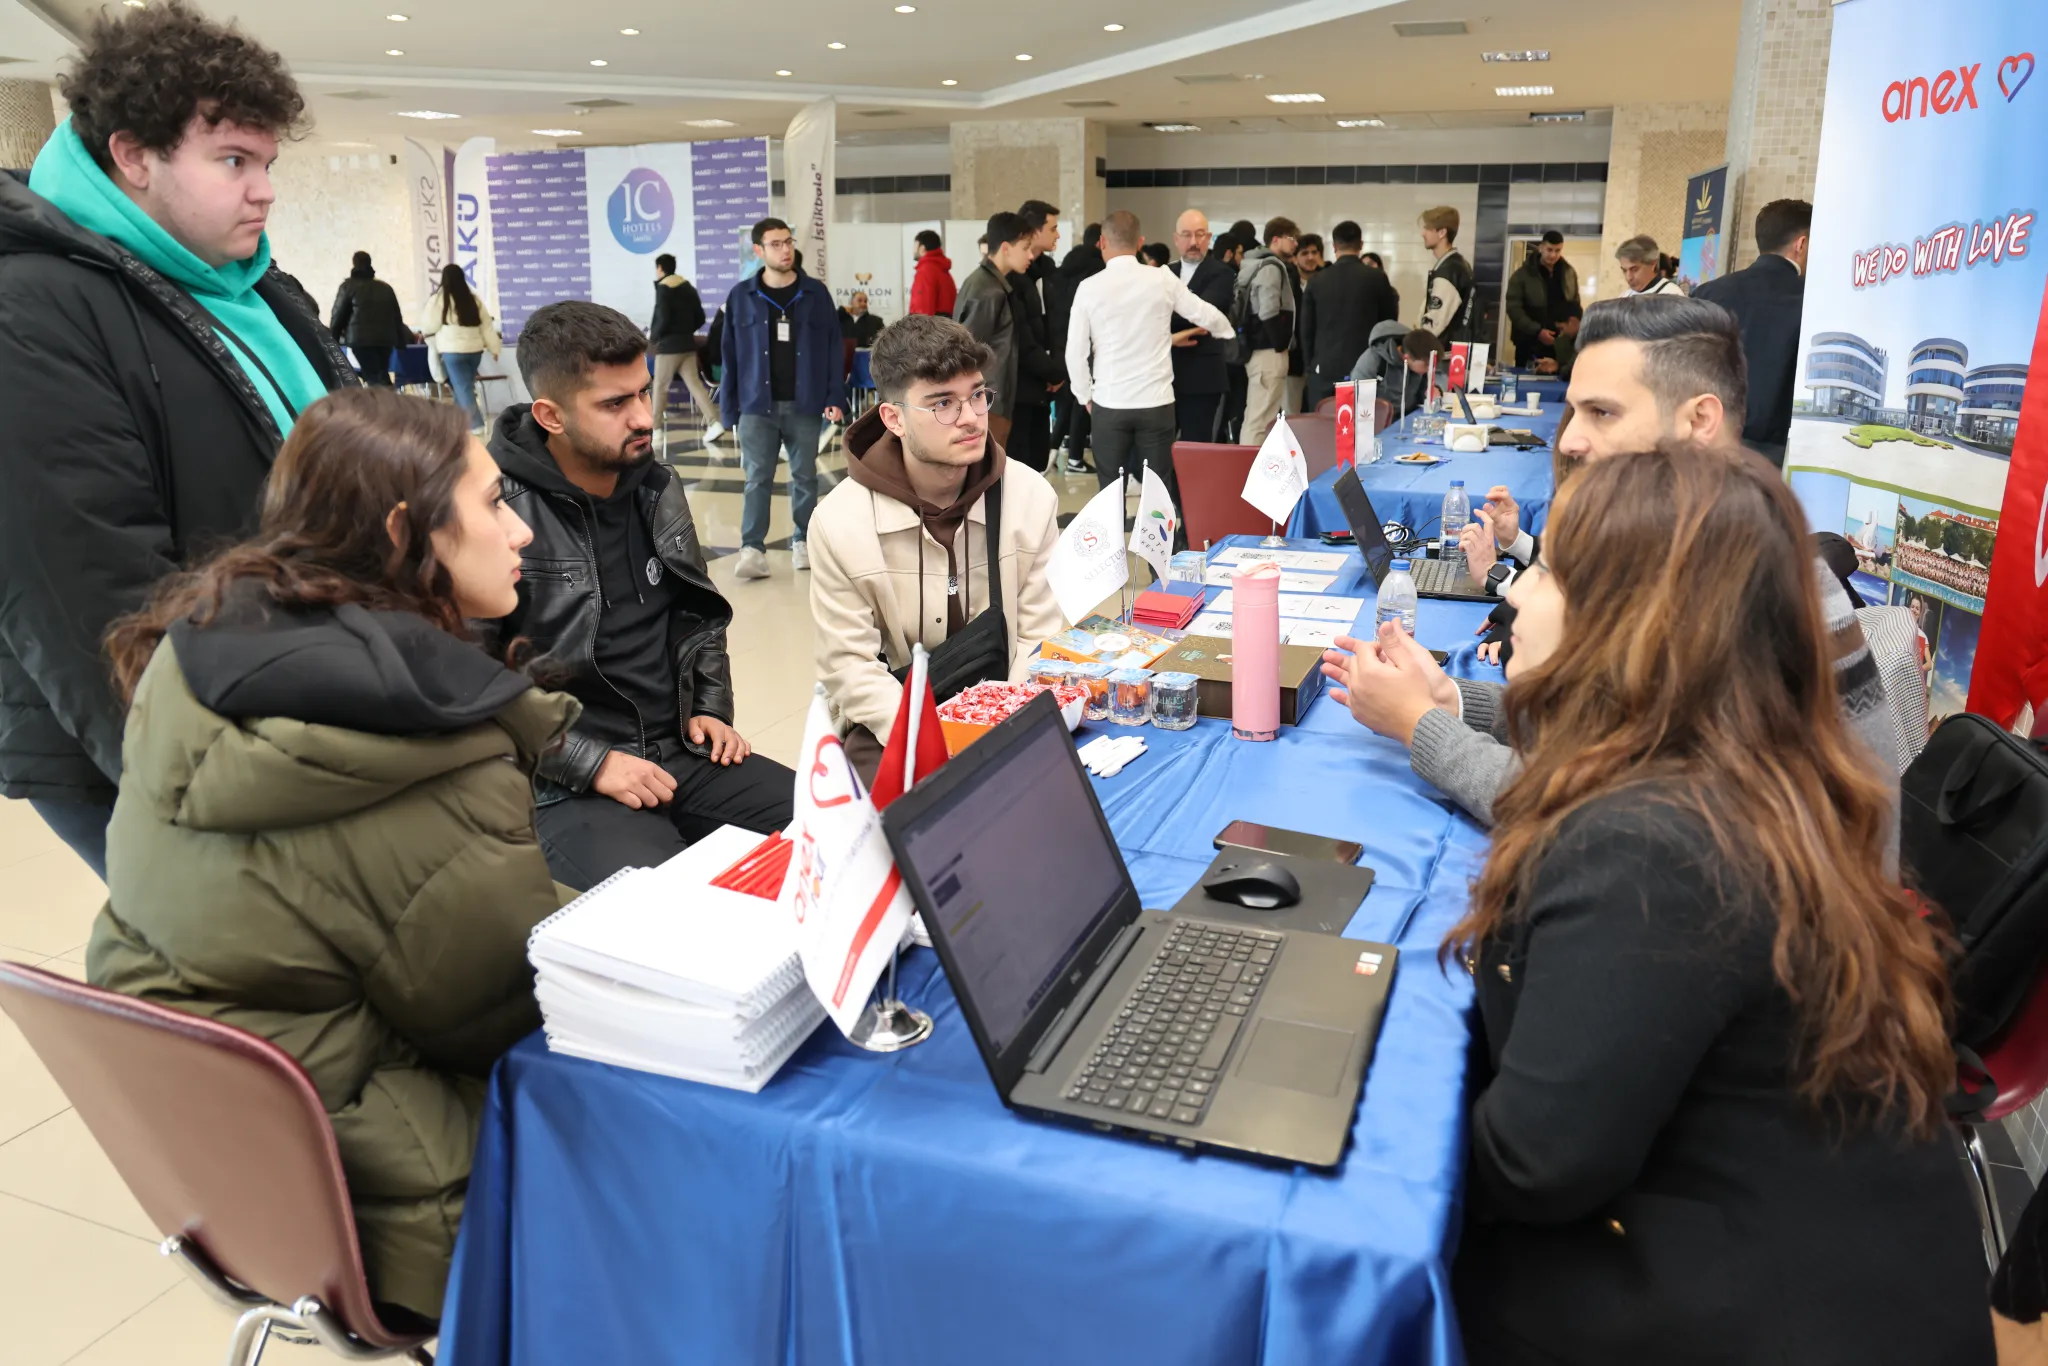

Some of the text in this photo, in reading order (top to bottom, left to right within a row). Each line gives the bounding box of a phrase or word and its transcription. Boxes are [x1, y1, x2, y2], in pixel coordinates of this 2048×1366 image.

[1881, 63, 1981, 123] anex
[457, 193, 479, 289] AKÜ
[622, 222, 661, 234] HOTELS
[1853, 249, 1880, 287] WE
[1881, 247, 1907, 281] DO
[1914, 226, 1964, 275] WITH
